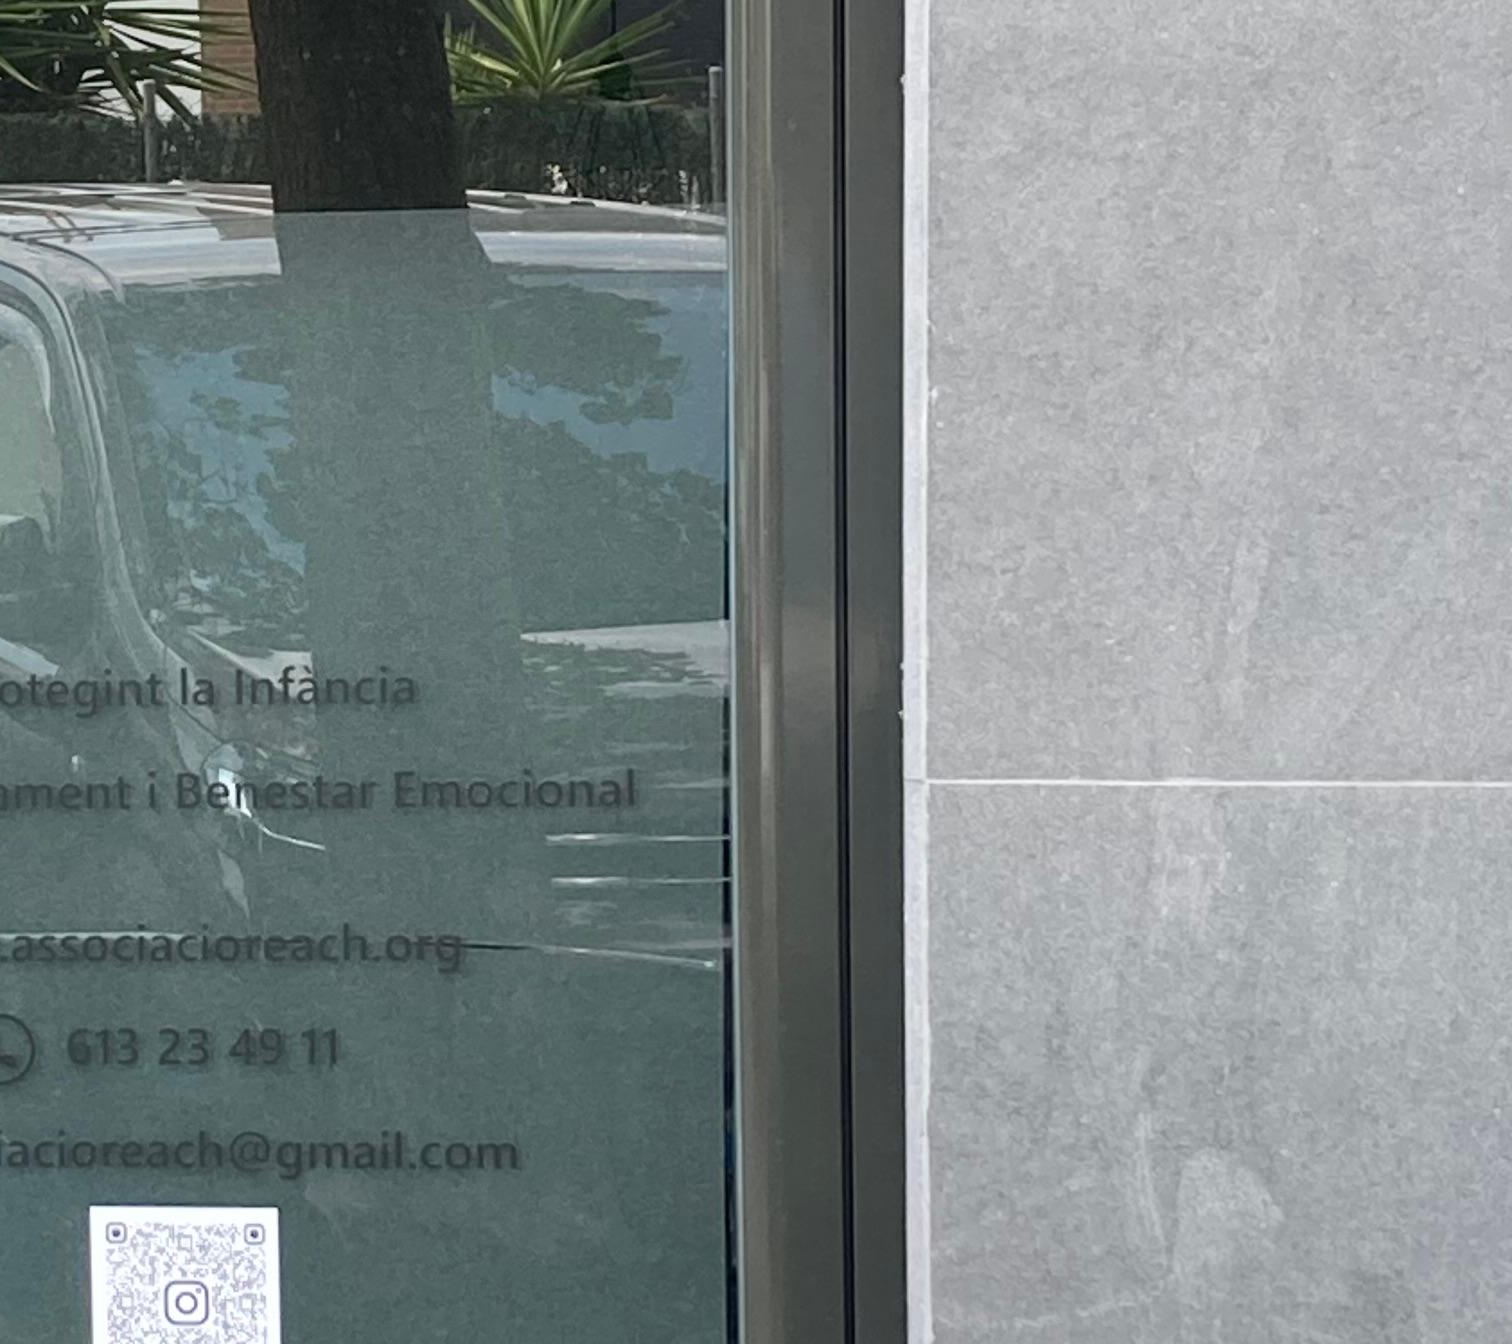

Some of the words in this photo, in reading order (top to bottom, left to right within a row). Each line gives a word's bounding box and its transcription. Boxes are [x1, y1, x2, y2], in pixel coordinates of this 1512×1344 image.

[180, 667, 216, 706] la
[235, 665, 417, 706] Infància
[147, 771, 157, 809] i
[176, 773, 376, 810] Benestar
[393, 768, 636, 809] Emocional
[66, 1027, 139, 1067] 613
[157, 1027, 211, 1067] 23
[228, 1027, 284, 1067] 49
[301, 1027, 340, 1067] 11
